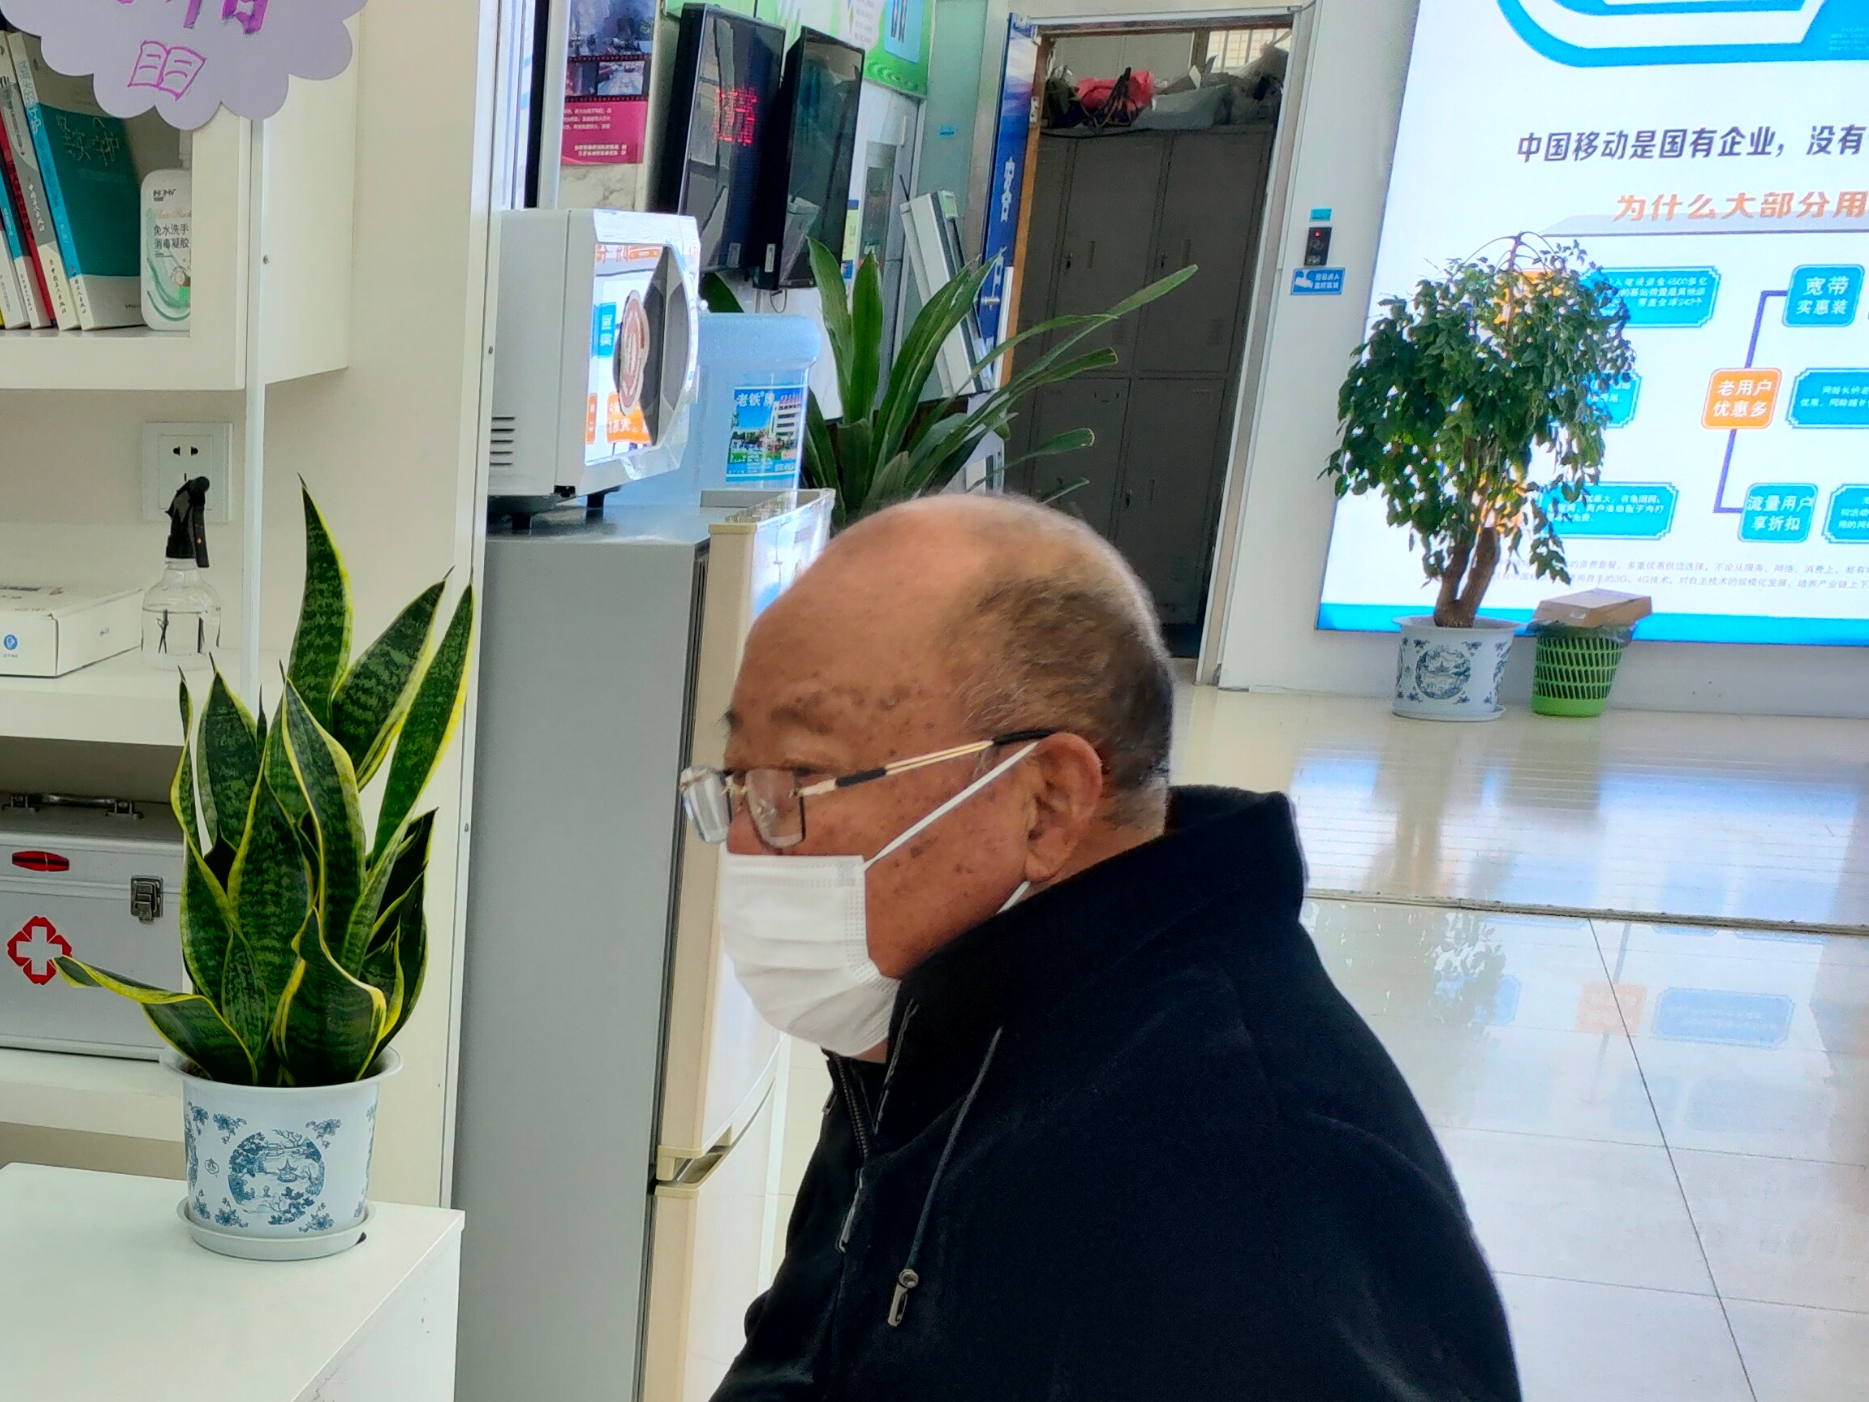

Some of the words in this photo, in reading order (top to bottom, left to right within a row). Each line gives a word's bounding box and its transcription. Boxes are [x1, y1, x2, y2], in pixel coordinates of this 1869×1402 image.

[1516, 123, 1869, 163] 中国移动是国有企业，没有
[1612, 190, 1869, 222] 为什么大部分用
[153, 223, 190, 237] 免水洗手
[153, 237, 190, 250] 消毒凝胶
[1803, 276, 1850, 296] 宽带
[1796, 299, 1849, 316] 实惠装
[1717, 379, 1773, 397] 老用户
[1713, 400, 1768, 418] 优惠多
[1746, 494, 1816, 512] 流量用户
[1752, 515, 1801, 532] 享折扣
